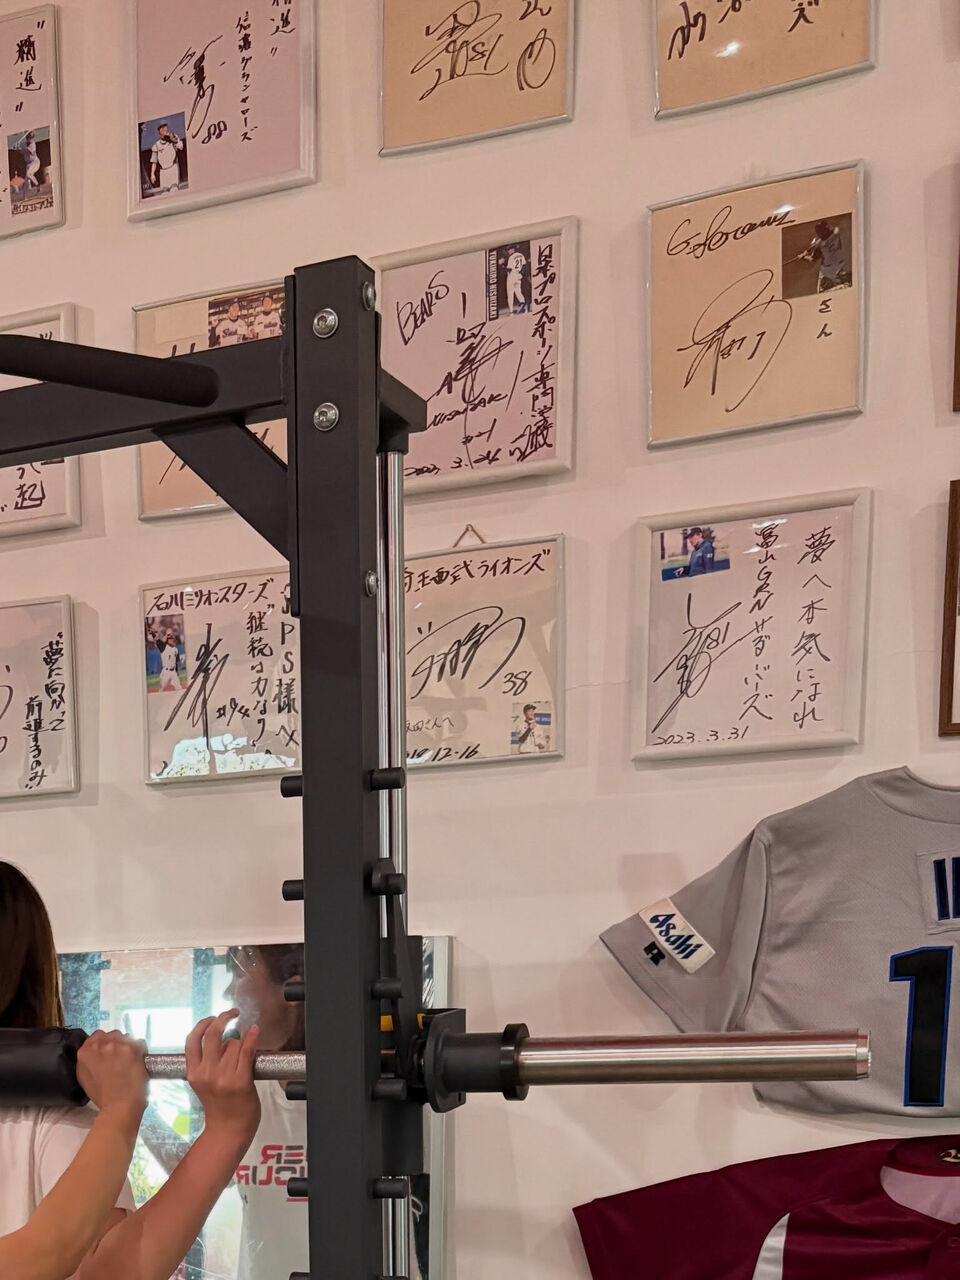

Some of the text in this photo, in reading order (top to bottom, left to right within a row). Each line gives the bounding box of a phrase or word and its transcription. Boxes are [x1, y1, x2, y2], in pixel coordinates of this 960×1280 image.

[201, 120, 228, 145] 88
[502, 670, 532, 697] 38
[649, 913, 704, 959] Asahi
